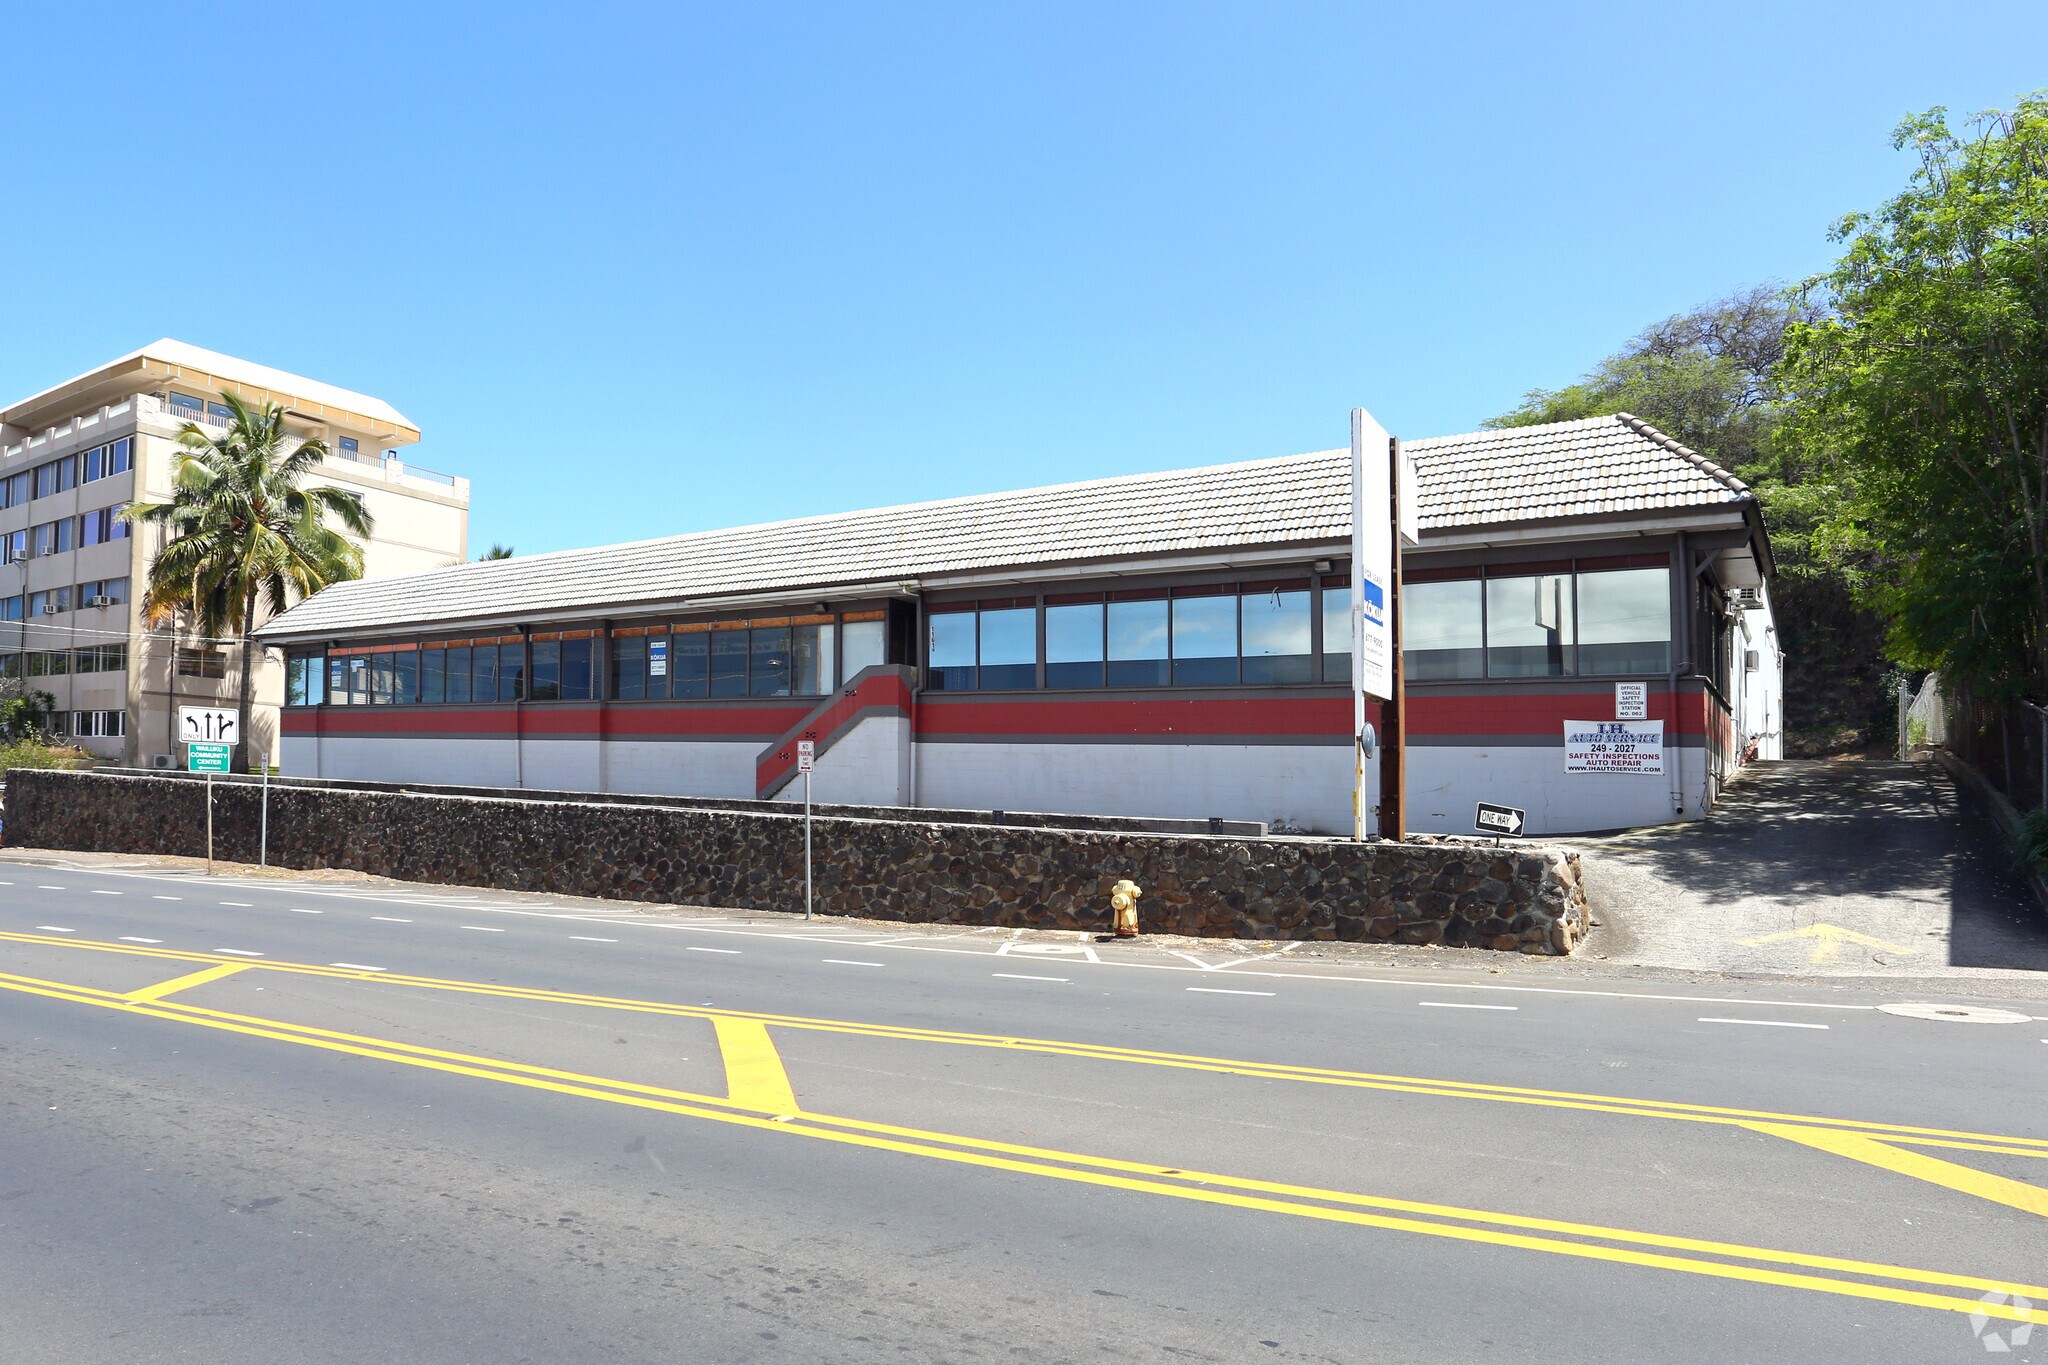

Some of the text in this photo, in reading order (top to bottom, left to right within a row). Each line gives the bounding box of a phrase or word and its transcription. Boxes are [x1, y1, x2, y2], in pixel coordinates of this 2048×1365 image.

[1597, 723, 1629, 734] I.H.
[1568, 733, 1660, 743] AUTO SERVICE
[1591, 744, 1607, 752] 249
[1615, 744, 1635, 752] 2027
[1481, 811, 1511, 826] ONE WAY
